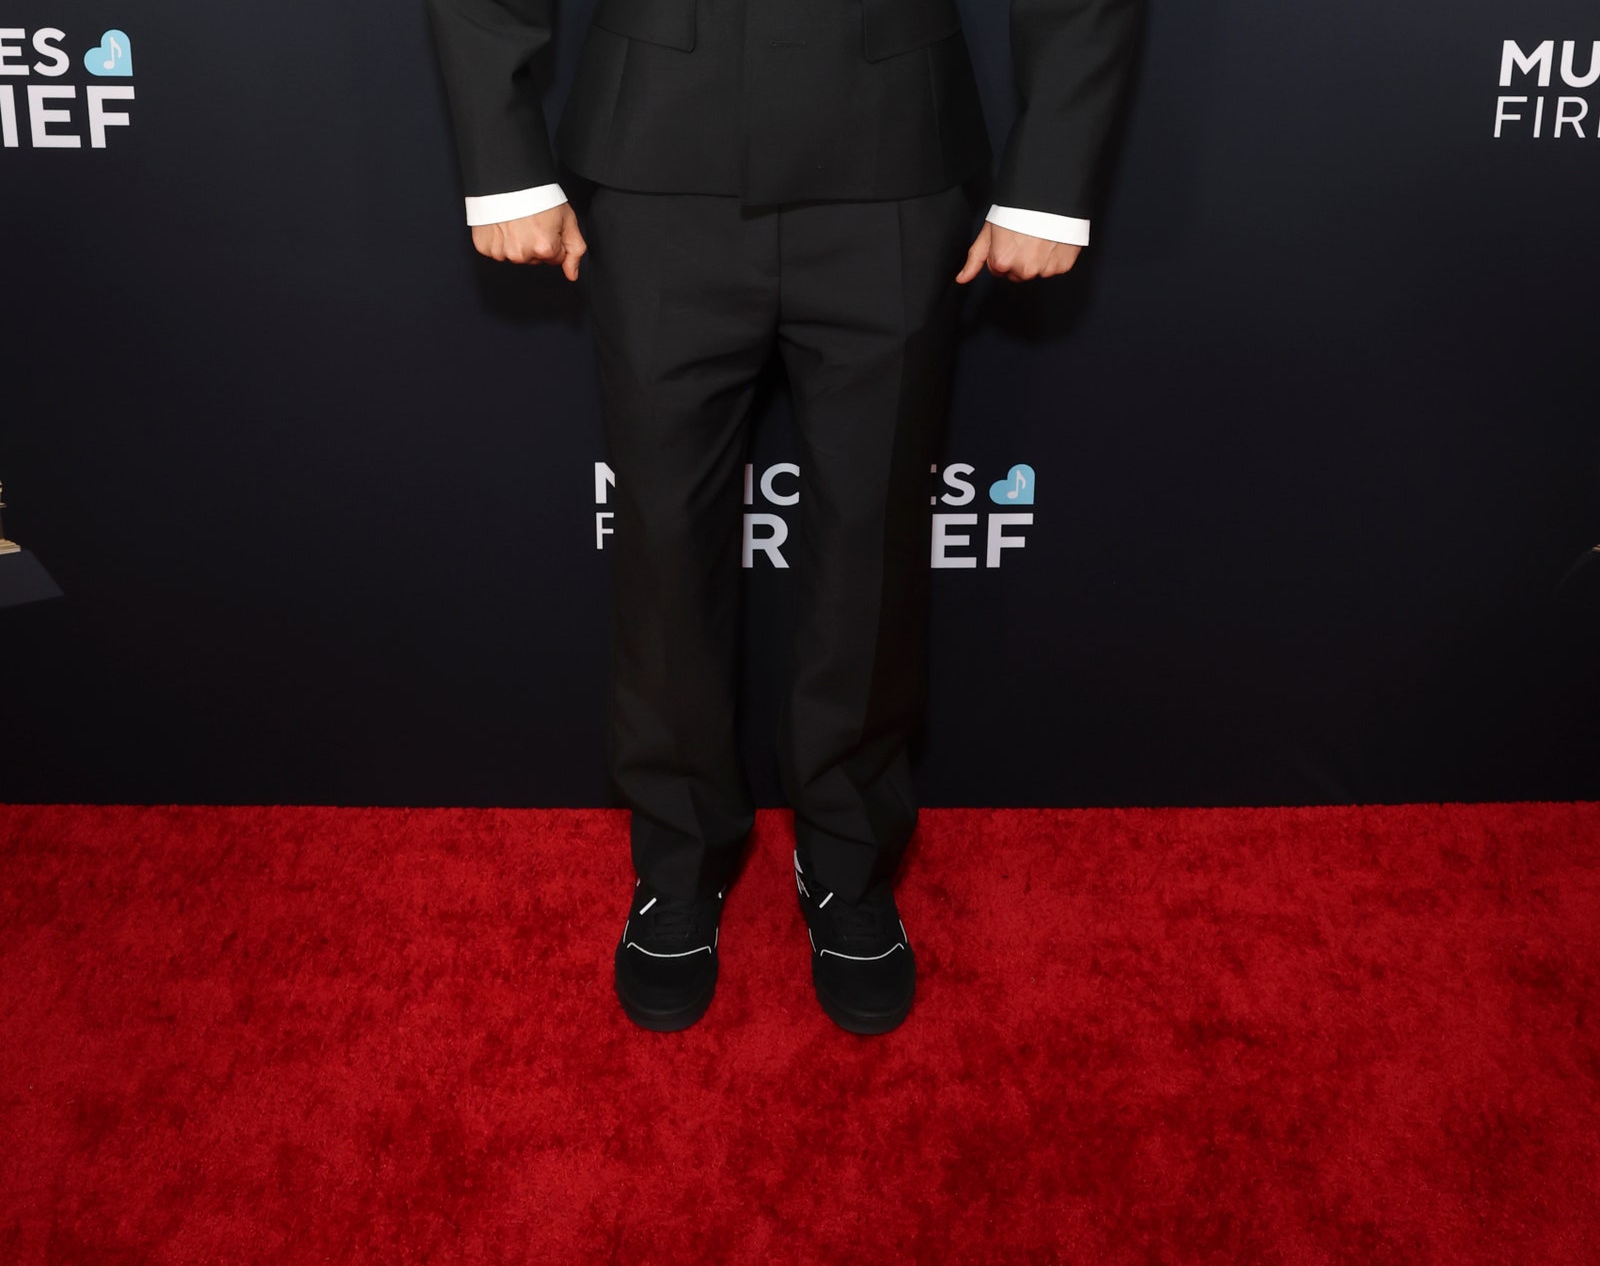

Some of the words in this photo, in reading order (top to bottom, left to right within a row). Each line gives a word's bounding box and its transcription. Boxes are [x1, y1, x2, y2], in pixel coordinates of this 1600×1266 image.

[0, 27, 70, 77] ES
[1499, 39, 1600, 88] MU
[0, 84, 135, 149] IEF
[1493, 95, 1600, 138] FIR
